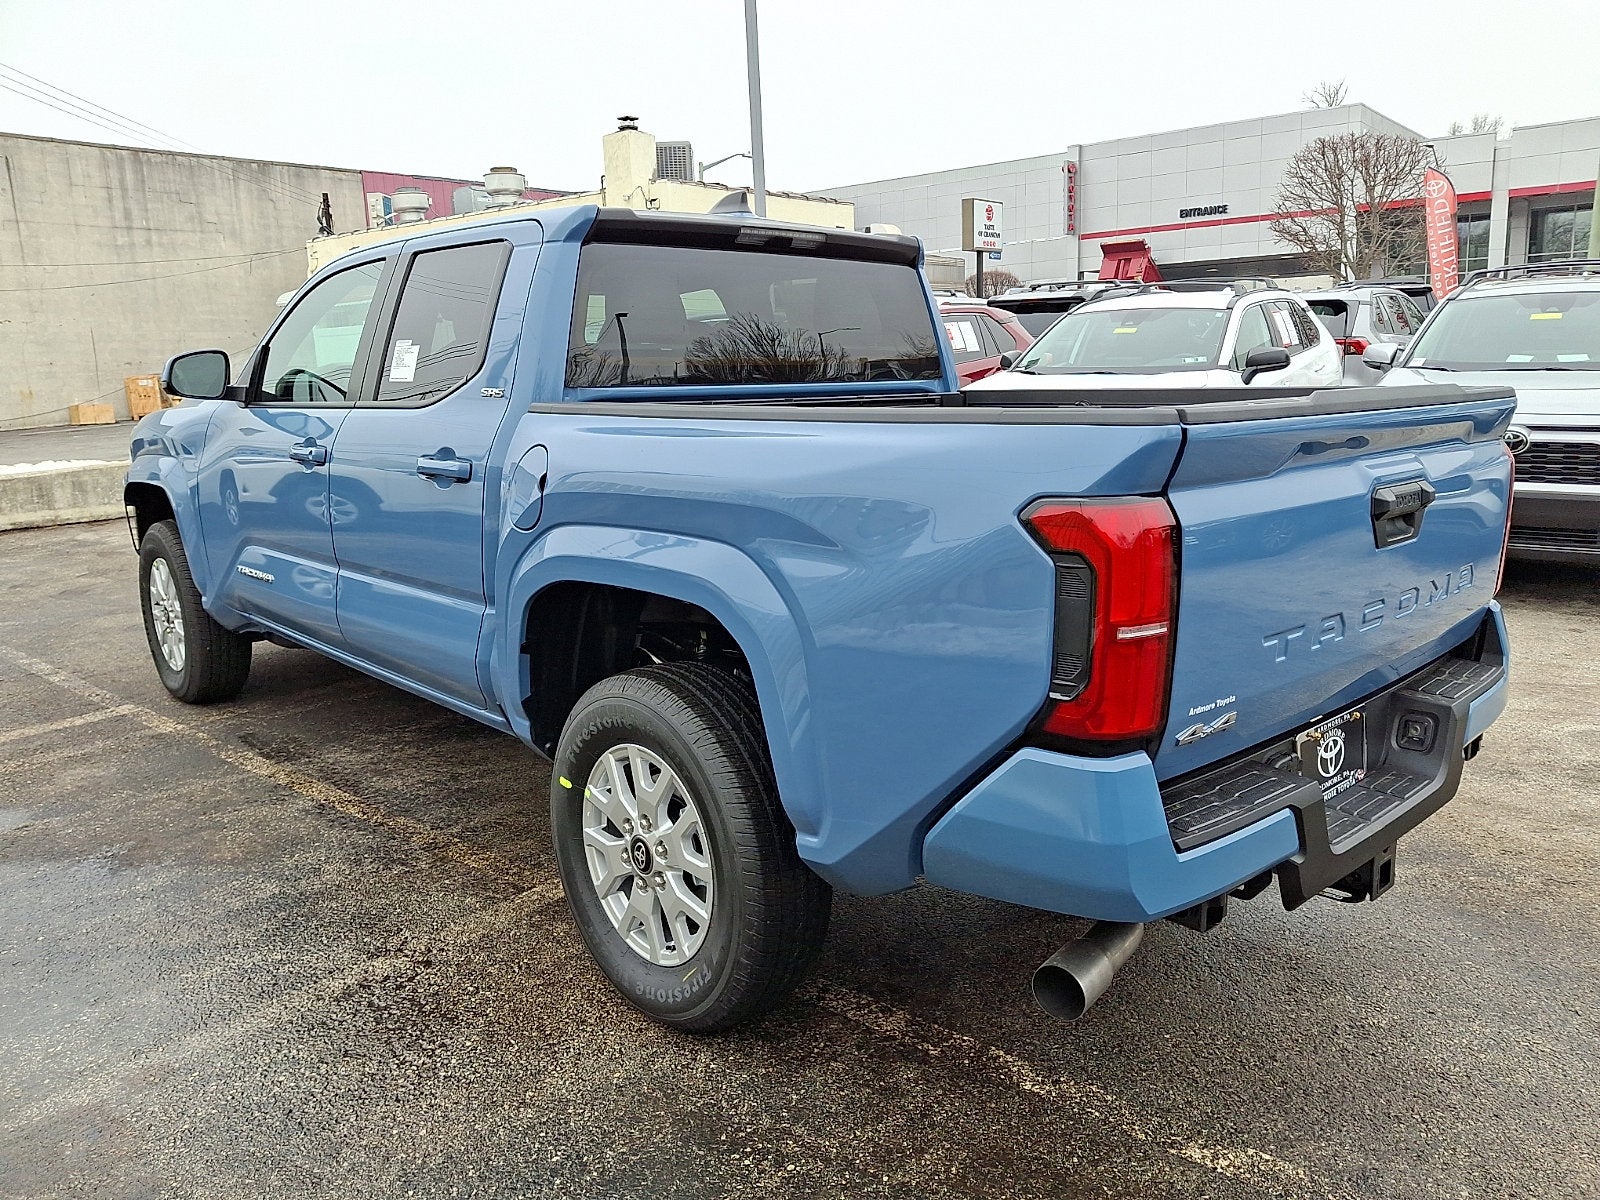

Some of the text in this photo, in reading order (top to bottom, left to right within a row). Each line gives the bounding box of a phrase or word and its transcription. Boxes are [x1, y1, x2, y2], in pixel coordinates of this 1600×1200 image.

[1179, 204, 1229, 218] ENTRANCE
[236, 565, 275, 583] TACOMA
[1261, 562, 1474, 663] TACOMA
[1188, 695, 1236, 717] Ardmore Toyota
[565, 715, 633, 764] Firestone
[1319, 774, 1343, 790] DMORE,
[635, 963, 712, 1004] Firestone
